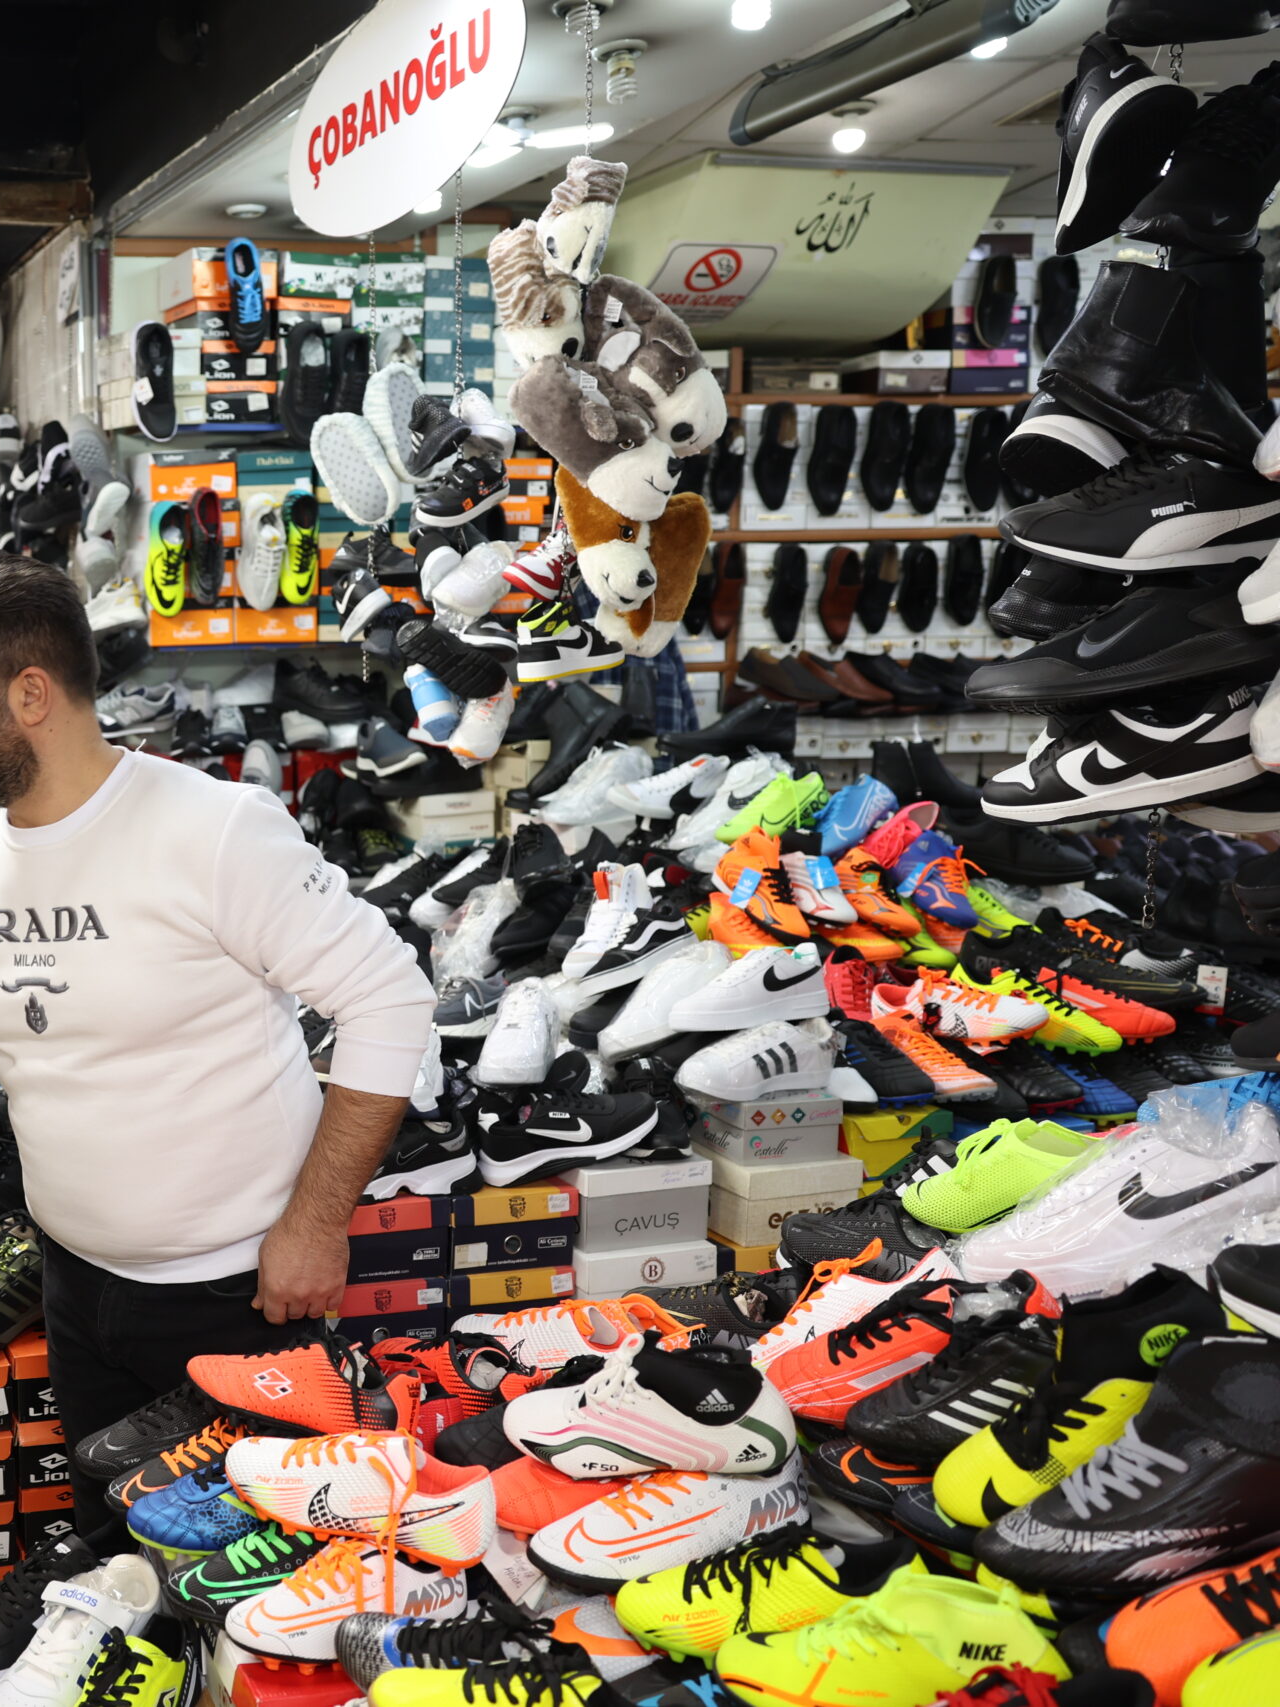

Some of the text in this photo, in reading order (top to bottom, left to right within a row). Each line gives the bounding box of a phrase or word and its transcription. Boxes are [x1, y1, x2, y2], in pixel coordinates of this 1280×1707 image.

[308, 8, 490, 190] ÇOBANOĞLU
[1151, 502, 1185, 518] PUMA
[1227, 684, 1252, 709] NIKE
[14, 953, 56, 968] MILANO
[614, 1212, 680, 1236] ÇAVUŞ
[696, 1402, 735, 1413] adidas
[735, 1451, 767, 1463] adidas
[59, 1586, 99, 1607] adidas
[958, 1641, 1008, 1661] NIKE
